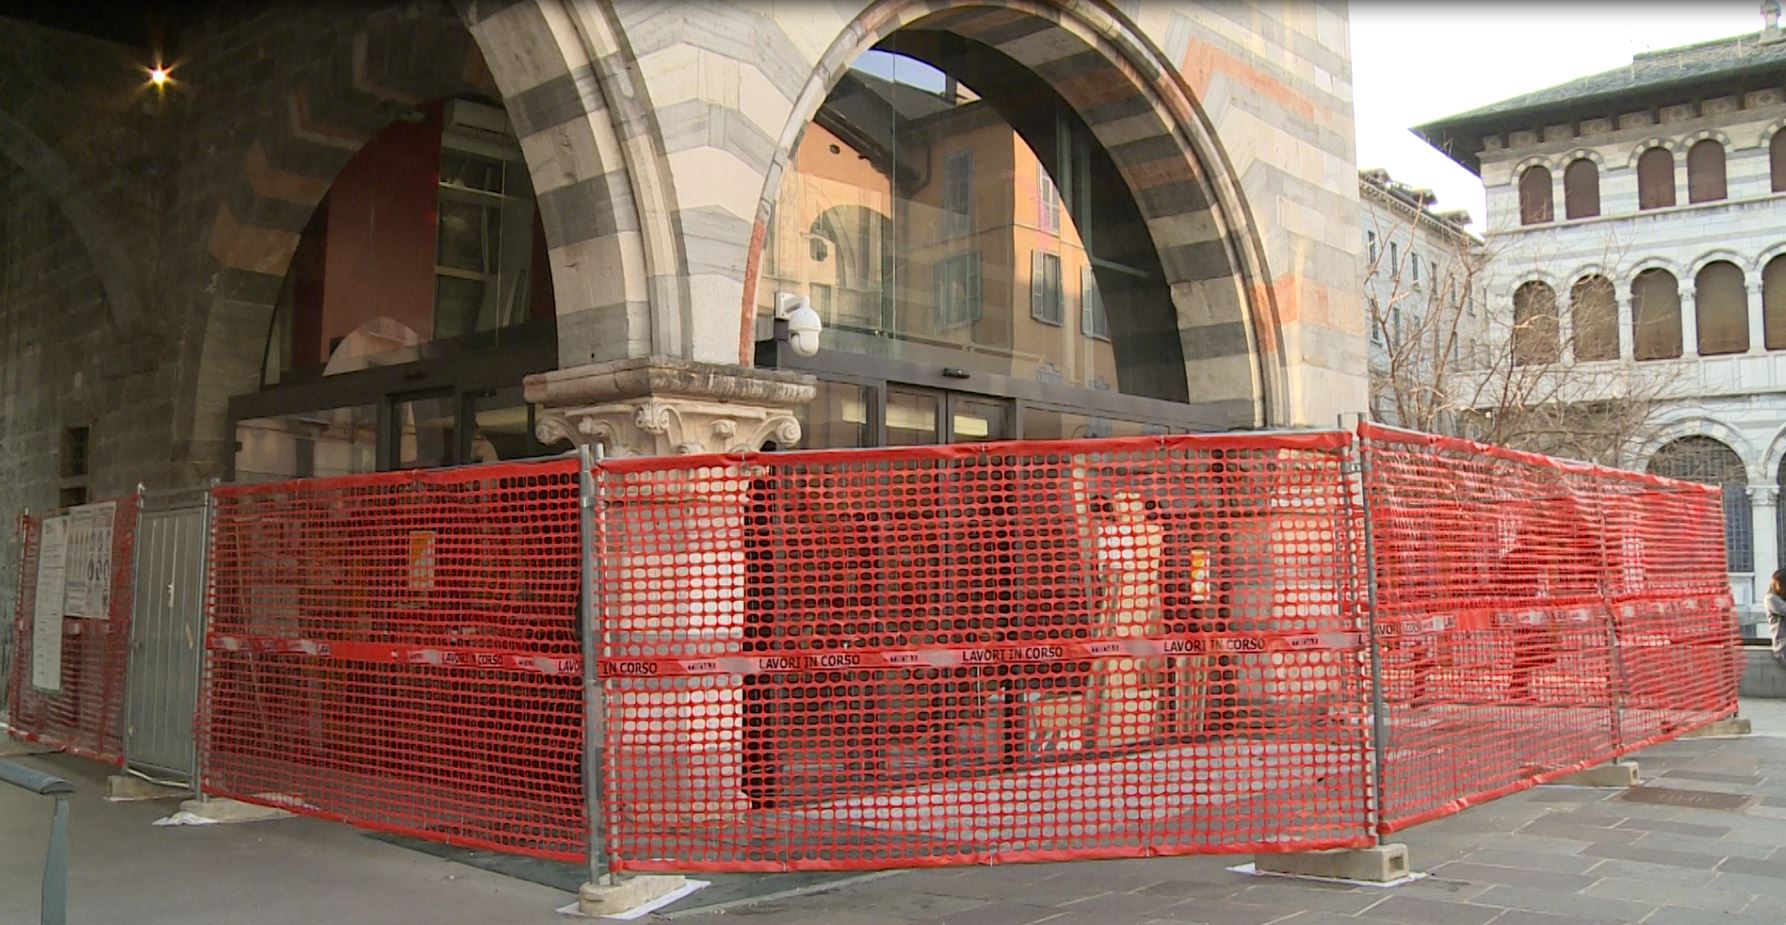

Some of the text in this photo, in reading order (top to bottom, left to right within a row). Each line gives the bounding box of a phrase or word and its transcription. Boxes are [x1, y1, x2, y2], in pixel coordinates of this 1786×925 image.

[1163, 638, 1266, 652] LAVORI IN CORSO
[478, 653, 504, 666] CORSO
[962, 646, 1064, 662] LAVORI IN CORSO
[602, 661, 658, 675] IN CORSO
[758, 654, 861, 670] LAVORI IN CORSO
